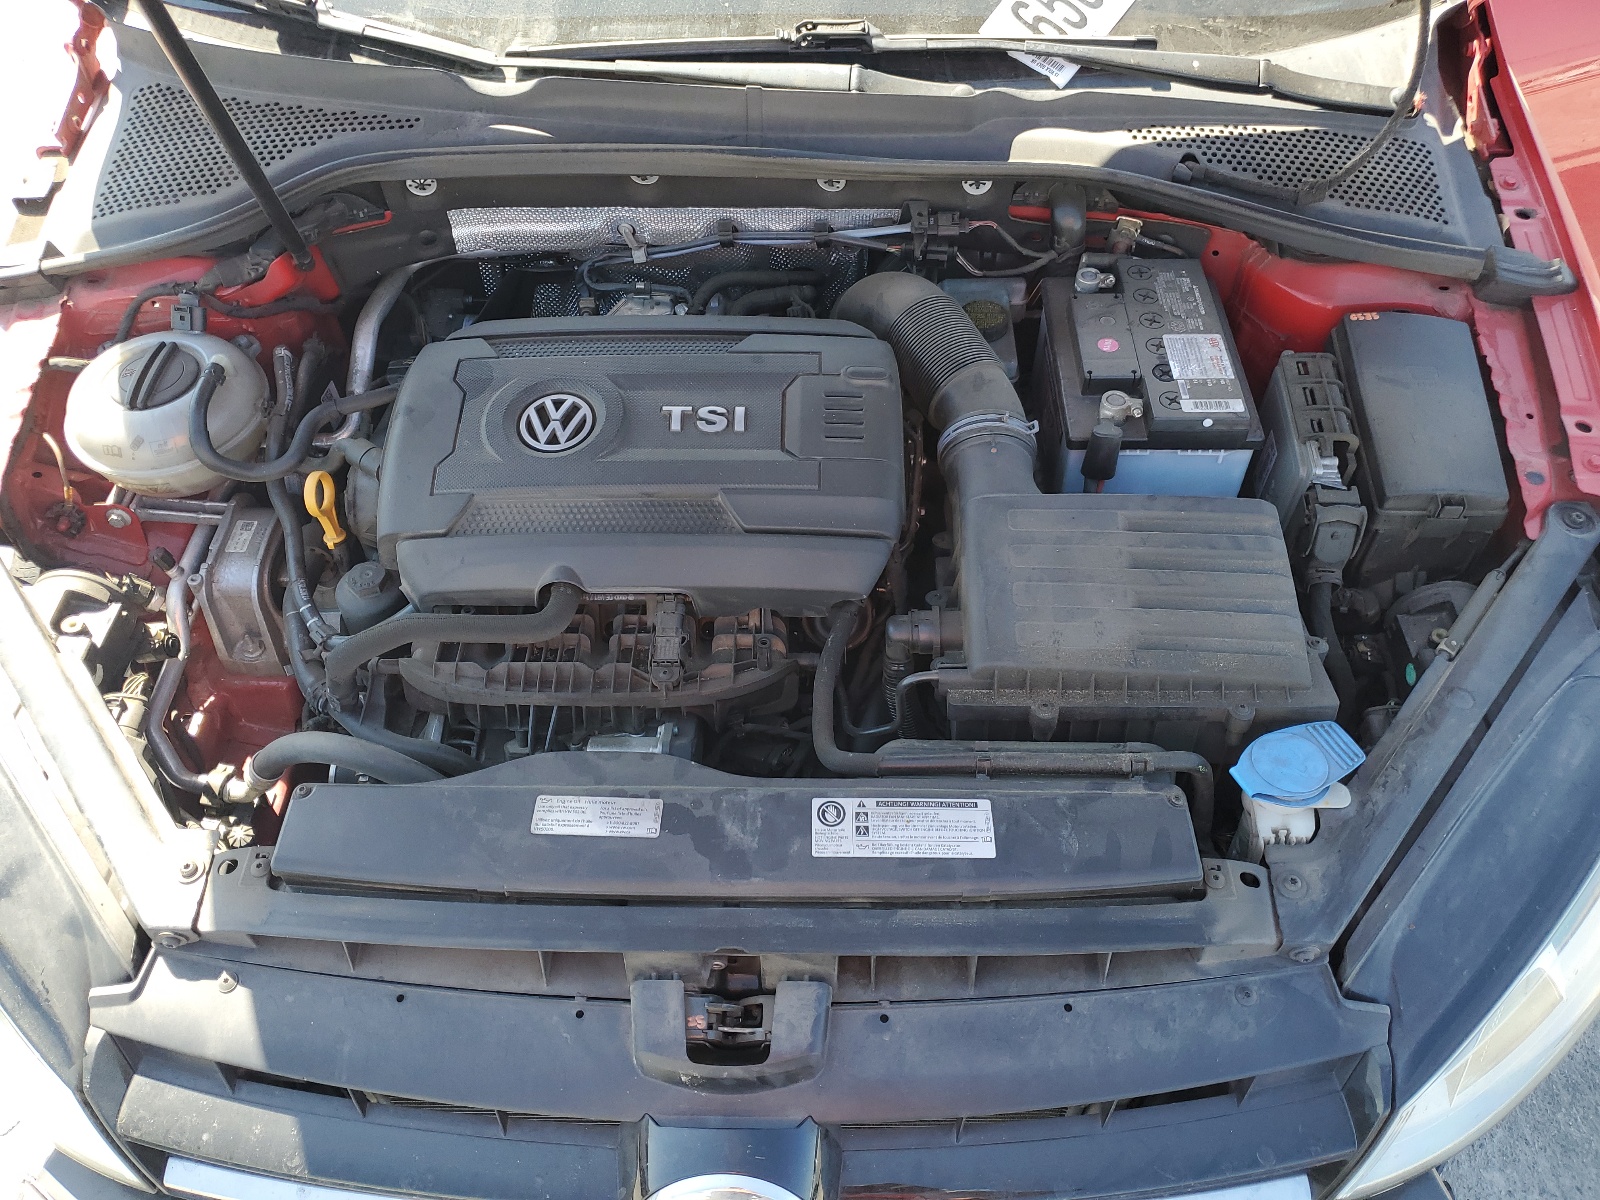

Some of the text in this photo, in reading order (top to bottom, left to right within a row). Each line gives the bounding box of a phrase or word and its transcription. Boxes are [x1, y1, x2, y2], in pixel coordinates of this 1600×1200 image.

[1010, 0, 1104, 36] 65
[519, 394, 593, 452] VW
[661, 405, 747, 433] TSI
